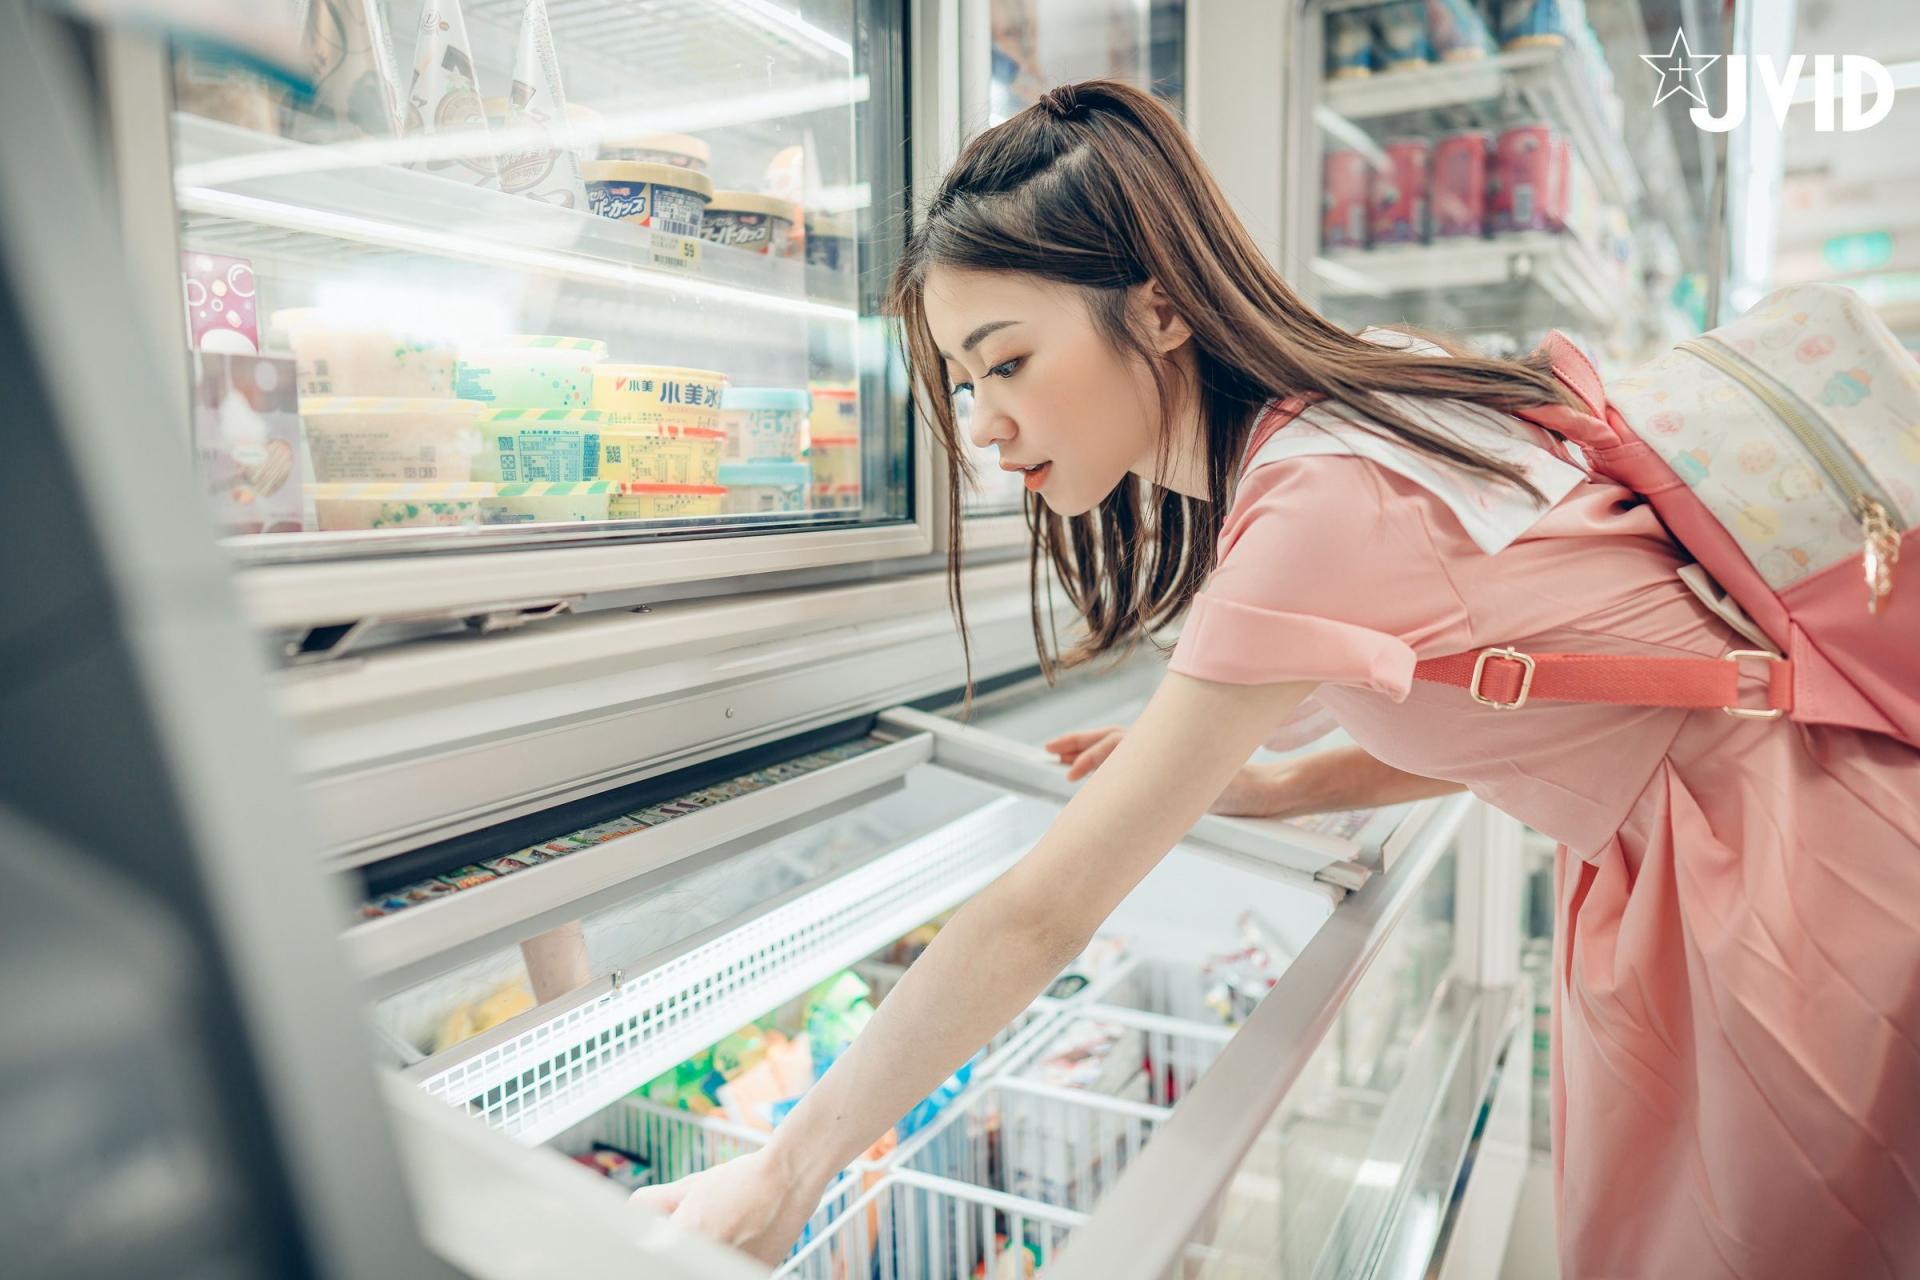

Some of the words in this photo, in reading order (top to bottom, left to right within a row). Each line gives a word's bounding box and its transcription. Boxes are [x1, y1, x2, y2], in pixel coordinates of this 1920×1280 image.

[684, 243, 695, 257] 59
[628, 379, 654, 392] 小美
[659, 381, 721, 409] 小美冰
